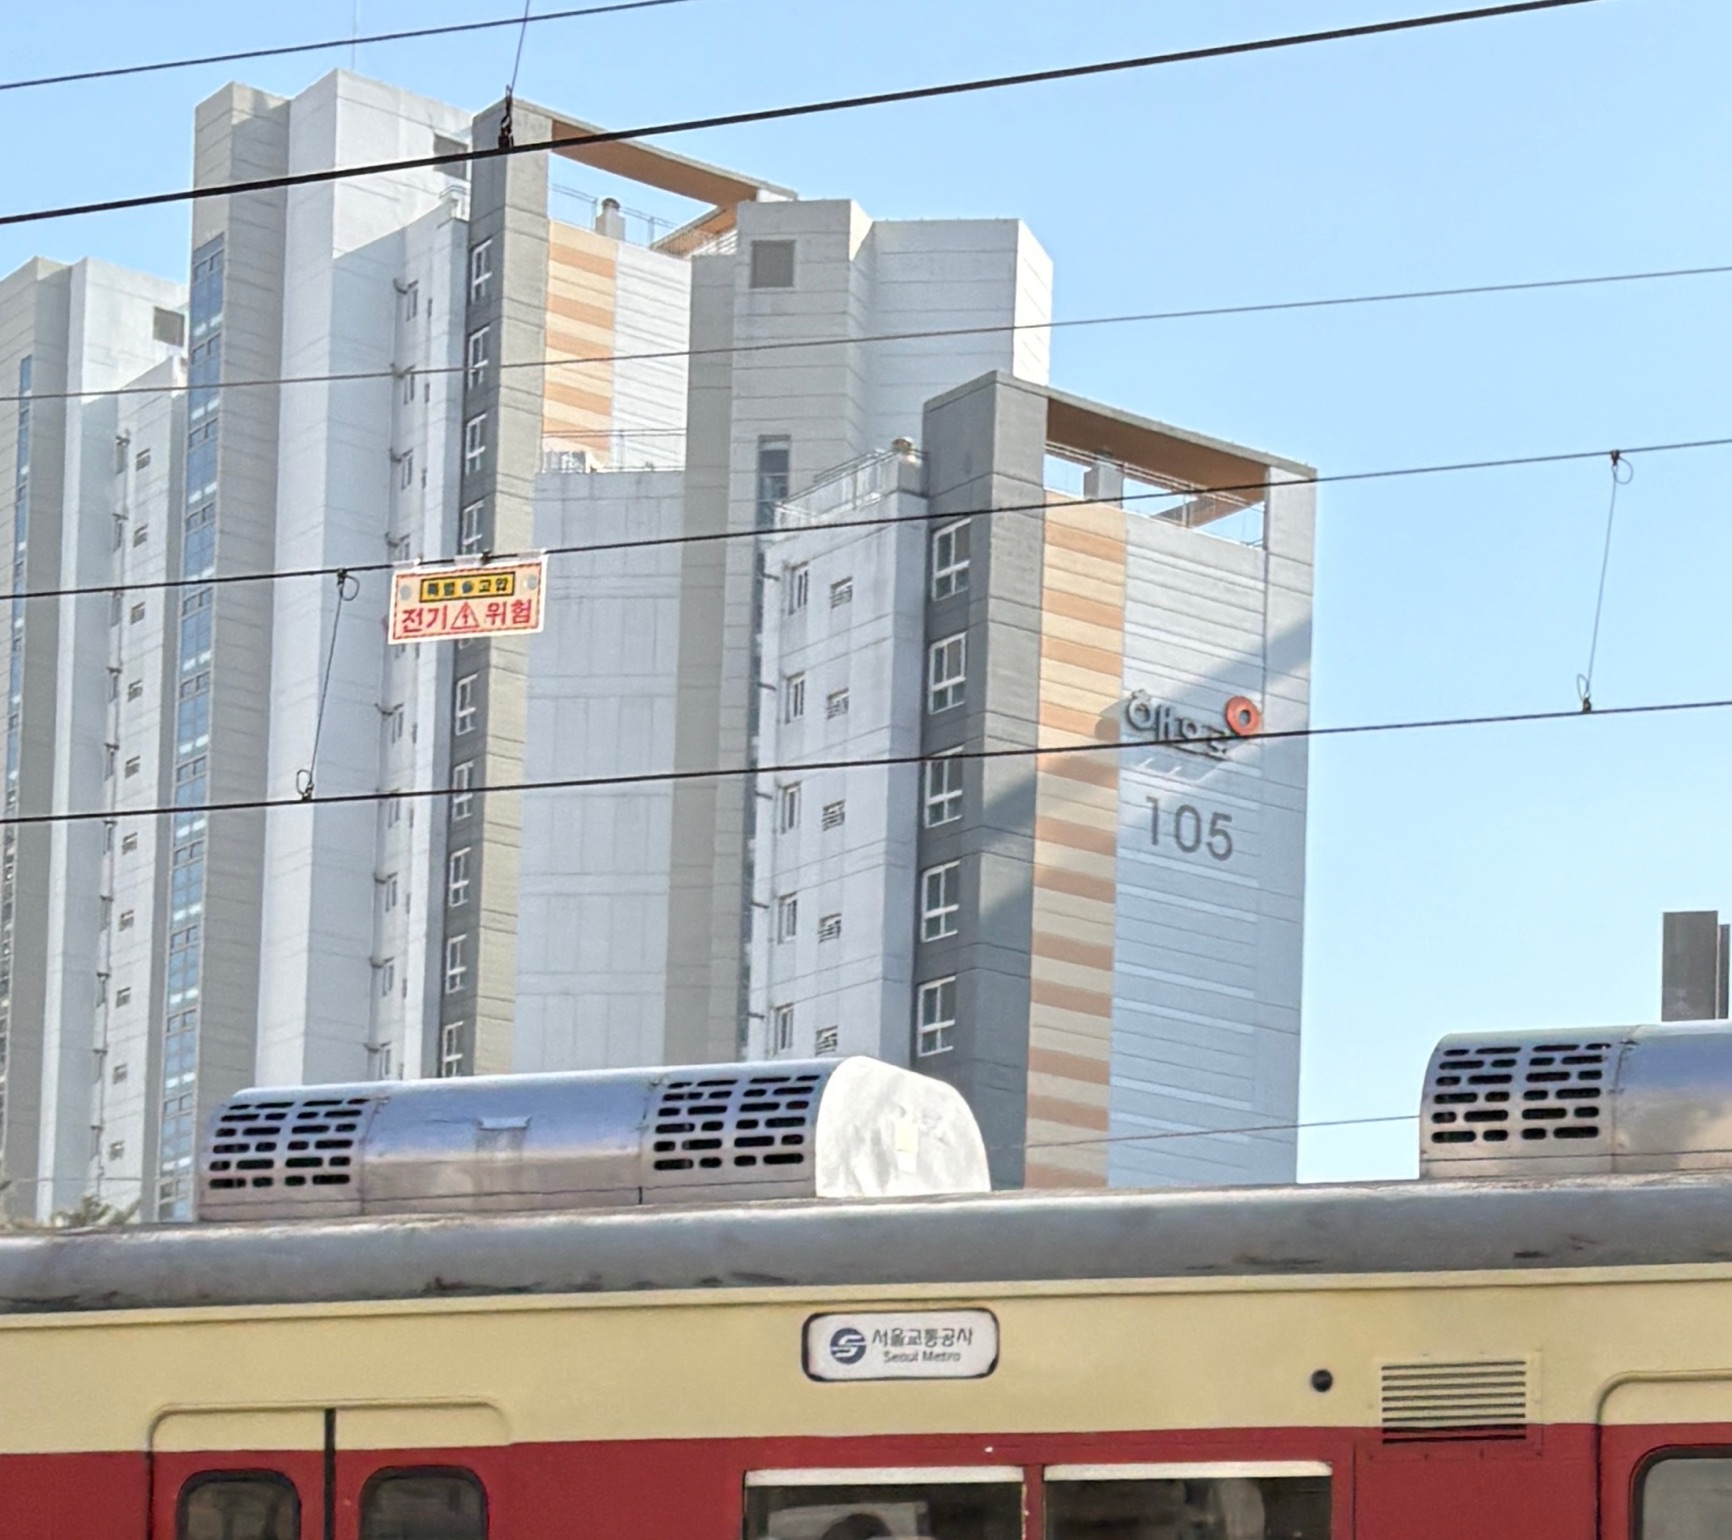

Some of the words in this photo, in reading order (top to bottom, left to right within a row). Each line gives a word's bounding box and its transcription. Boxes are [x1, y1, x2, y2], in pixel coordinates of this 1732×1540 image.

[402, 605, 448, 633] 전기
[485, 598, 532, 626] 위험
[1146, 796, 1233, 861] 105
[872, 1327, 973, 1348] 서울교통공사
[883, 1351, 919, 1363] Seoul
[922, 1350, 961, 1363] Metro
